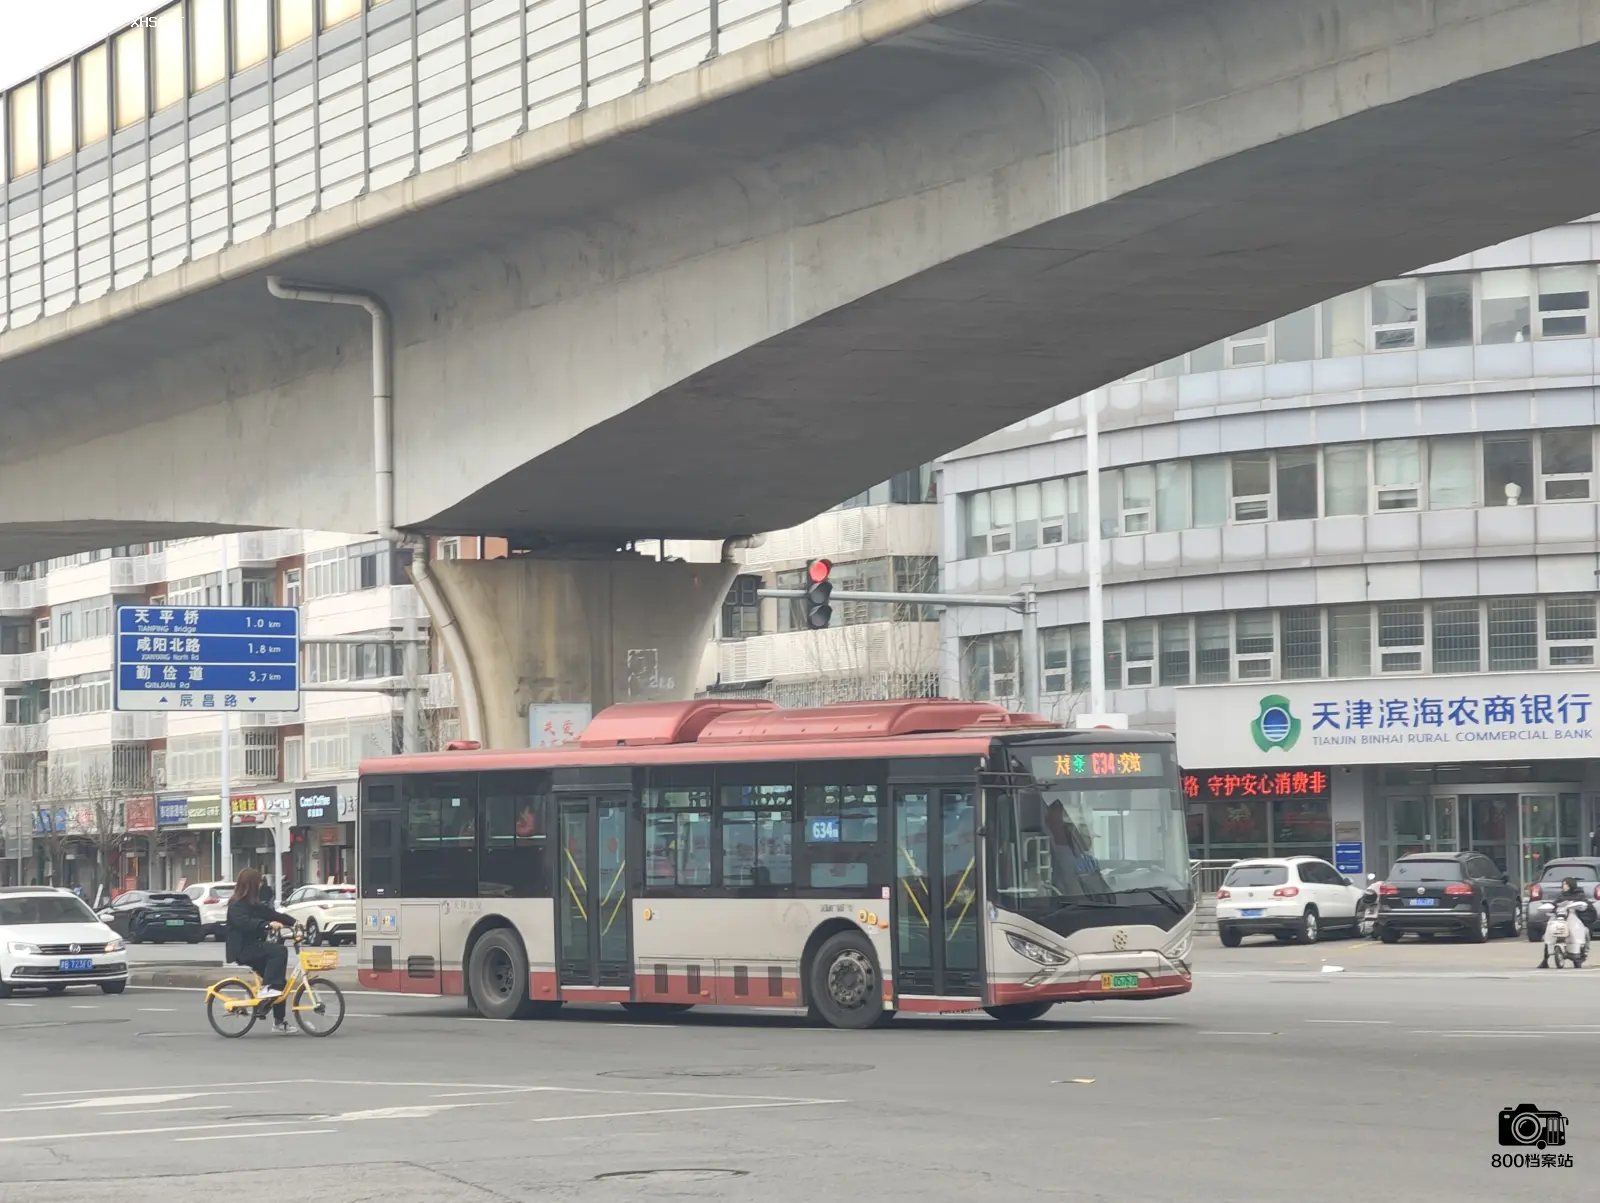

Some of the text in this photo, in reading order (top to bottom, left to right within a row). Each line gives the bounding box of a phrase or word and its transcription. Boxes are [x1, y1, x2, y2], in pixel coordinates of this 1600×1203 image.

[135, 609, 199, 625] 天平桥
[245, 617, 281, 628] 1.0 km
[174, 625, 197, 634] Bridge
[136, 638, 200, 653] 咸阳北路
[248, 643, 266, 654] 1.8
[191, 653, 199, 661] Rd
[136, 665, 204, 681] 勤俭道
[248, 671, 281, 682] 3.7 km
[144, 681, 190, 689] QINJIAN Rd
[179, 694, 237, 708] 辰昌路
[1311, 693, 1592, 731] 天津滨海农商银行
[1312, 728, 1593, 746] TIANJIN BINHAI RURAL COMMERCIAL BANK
[1090, 752, 1115, 775] 634
[1207, 771, 1327, 797] 守护安心消费非
